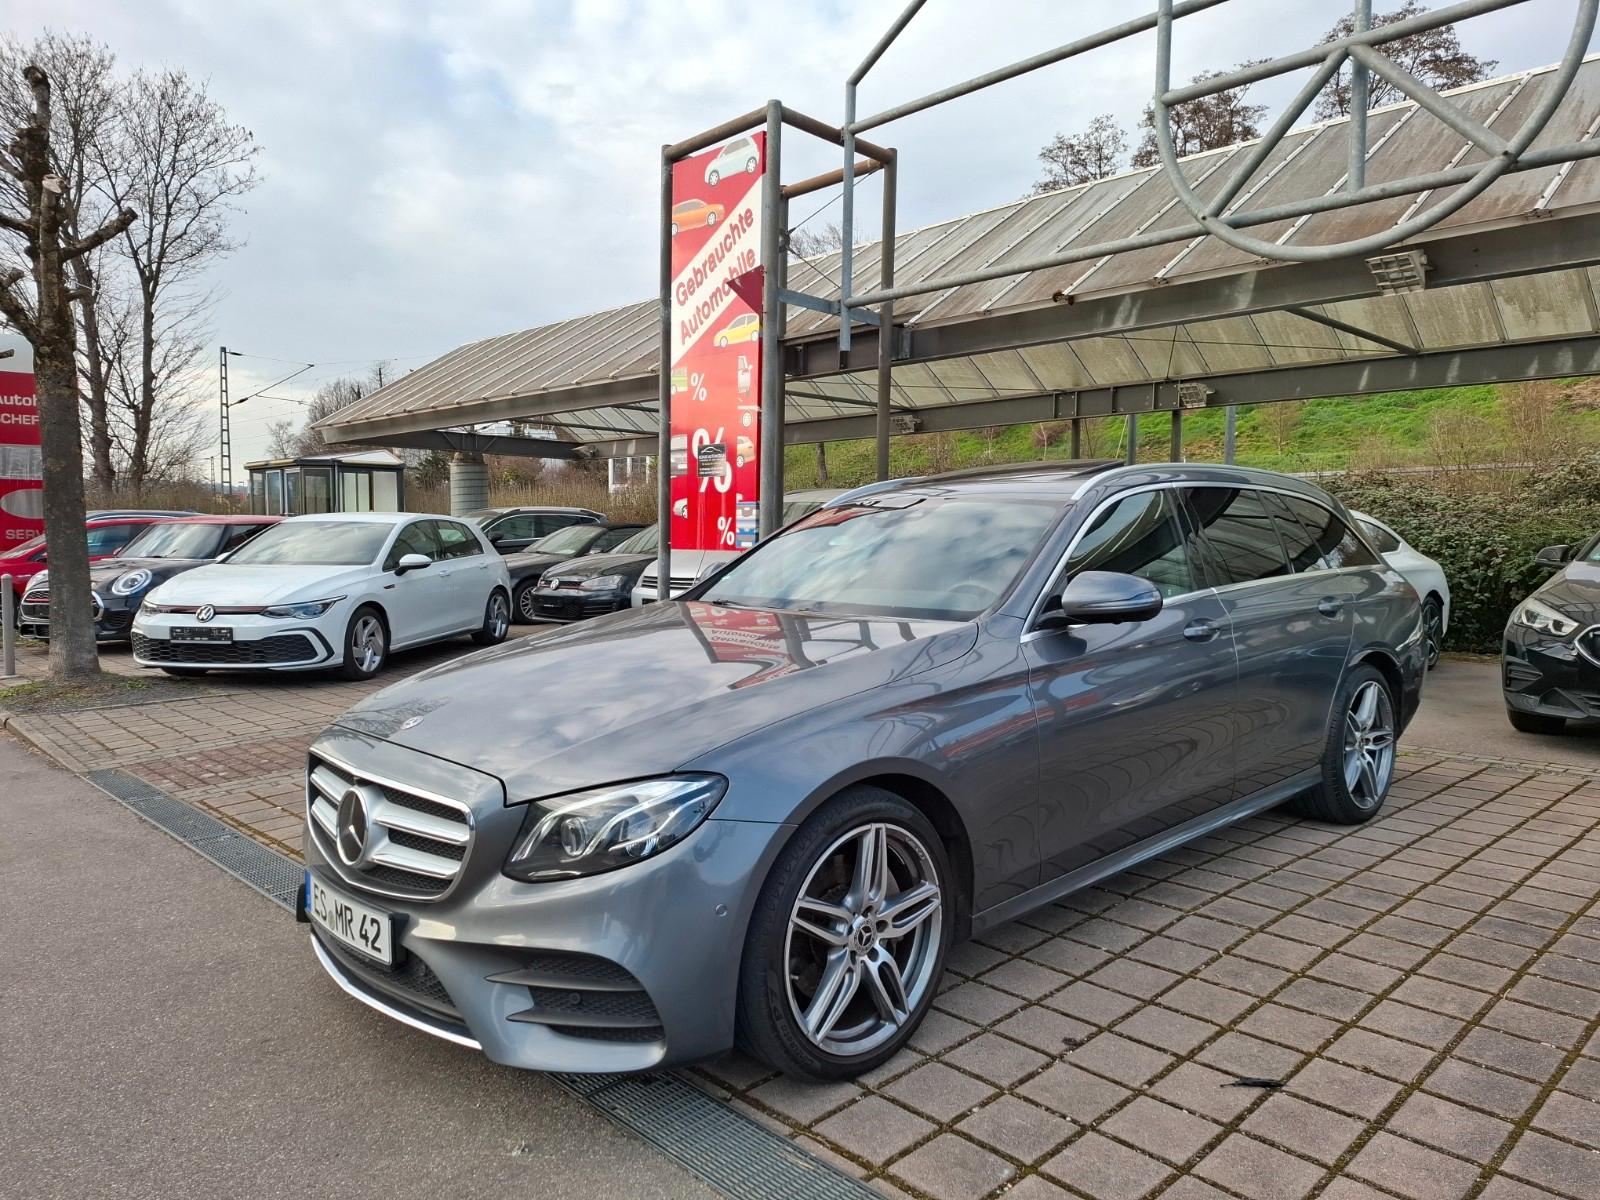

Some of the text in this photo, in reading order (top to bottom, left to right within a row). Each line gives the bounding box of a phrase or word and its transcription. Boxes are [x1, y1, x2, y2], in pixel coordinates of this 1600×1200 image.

[675, 207, 754, 306] Gebrauchte
[680, 248, 756, 345] Automobile
[313, 882, 382, 953] ES MR 42
